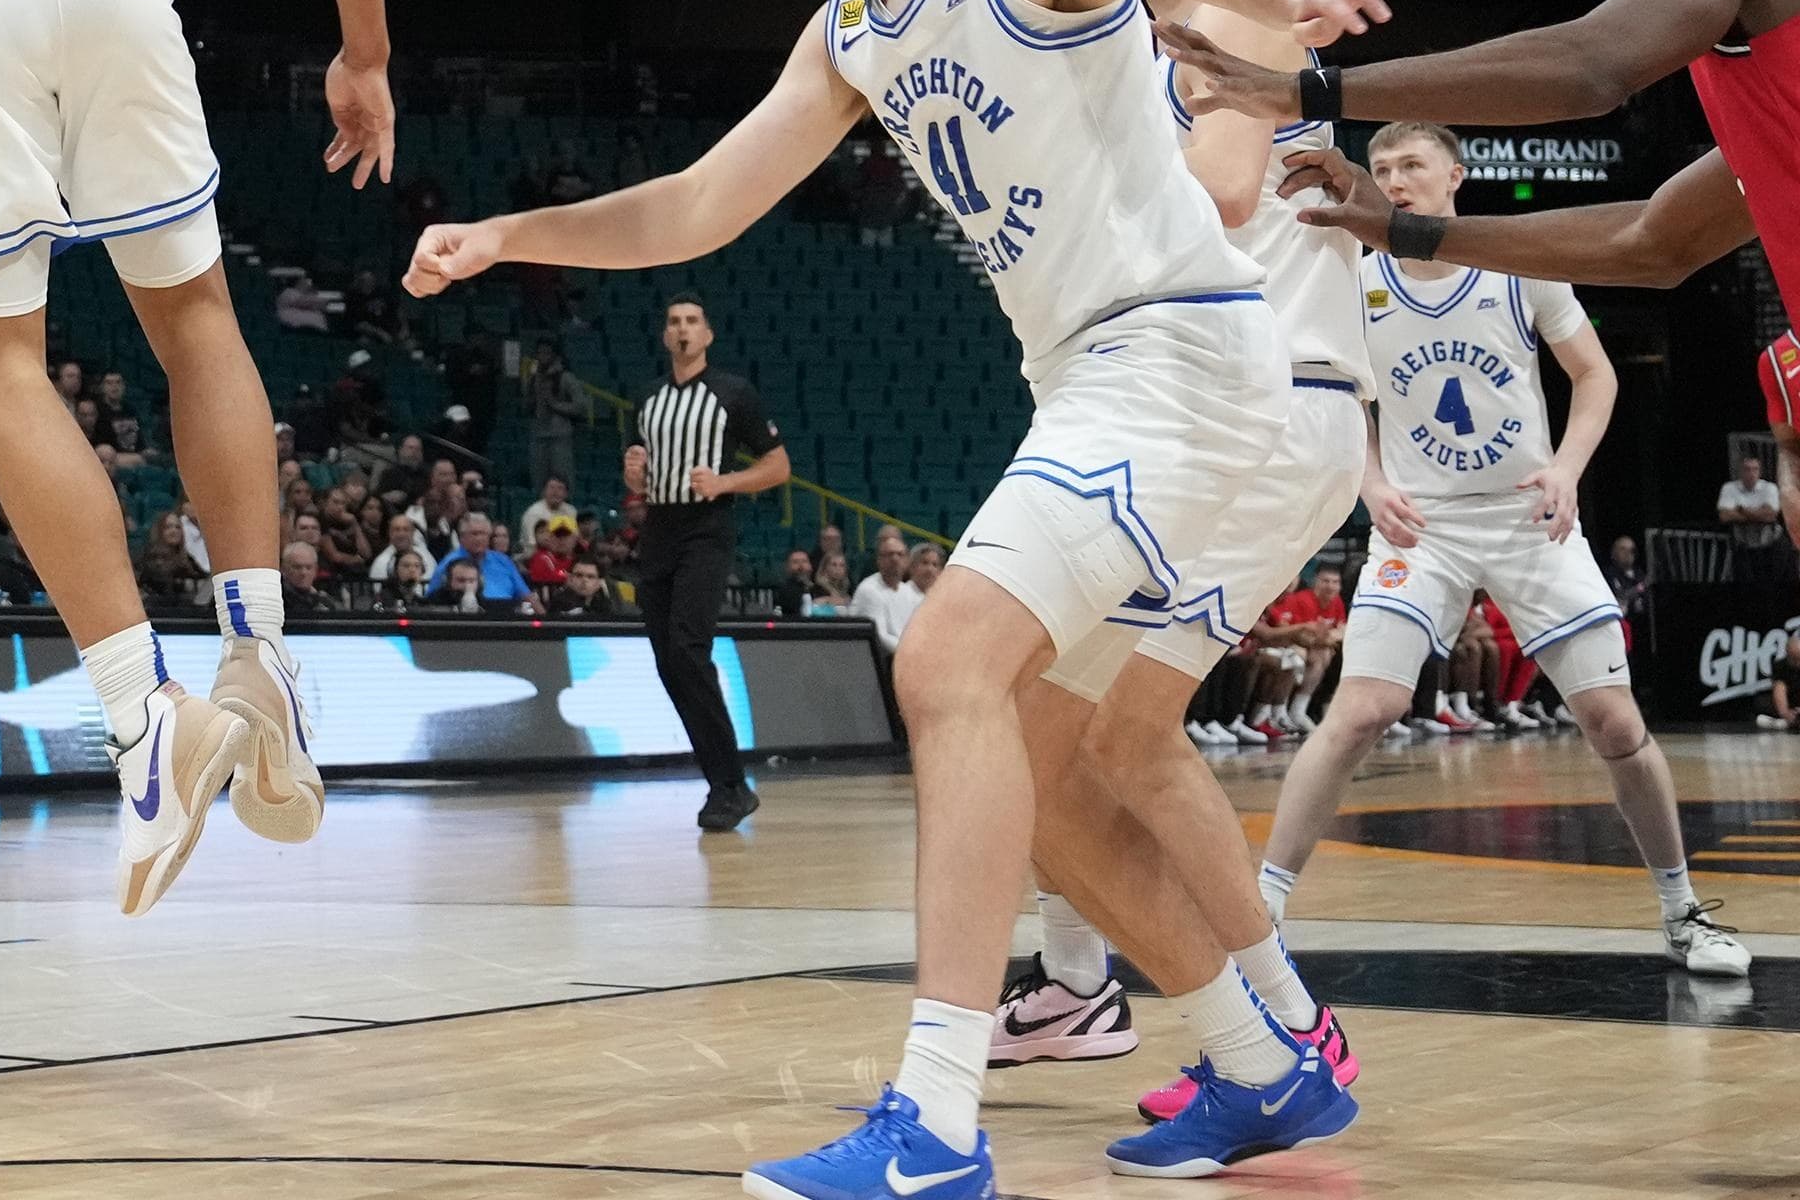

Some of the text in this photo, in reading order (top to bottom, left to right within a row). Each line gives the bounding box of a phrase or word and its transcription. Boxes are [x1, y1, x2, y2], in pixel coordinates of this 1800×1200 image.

[882, 57, 1015, 156] CREIGHTON
[927, 115, 991, 216] 41
[1521, 137, 1625, 163] GRAND
[1543, 166, 1609, 182] ARENA
[968, 184, 1043, 274] EJAYS
[1390, 339, 1515, 398] CREIGHTON
[1434, 376, 1476, 437] 4
[1410, 417, 1522, 472] BLUEJAYS
